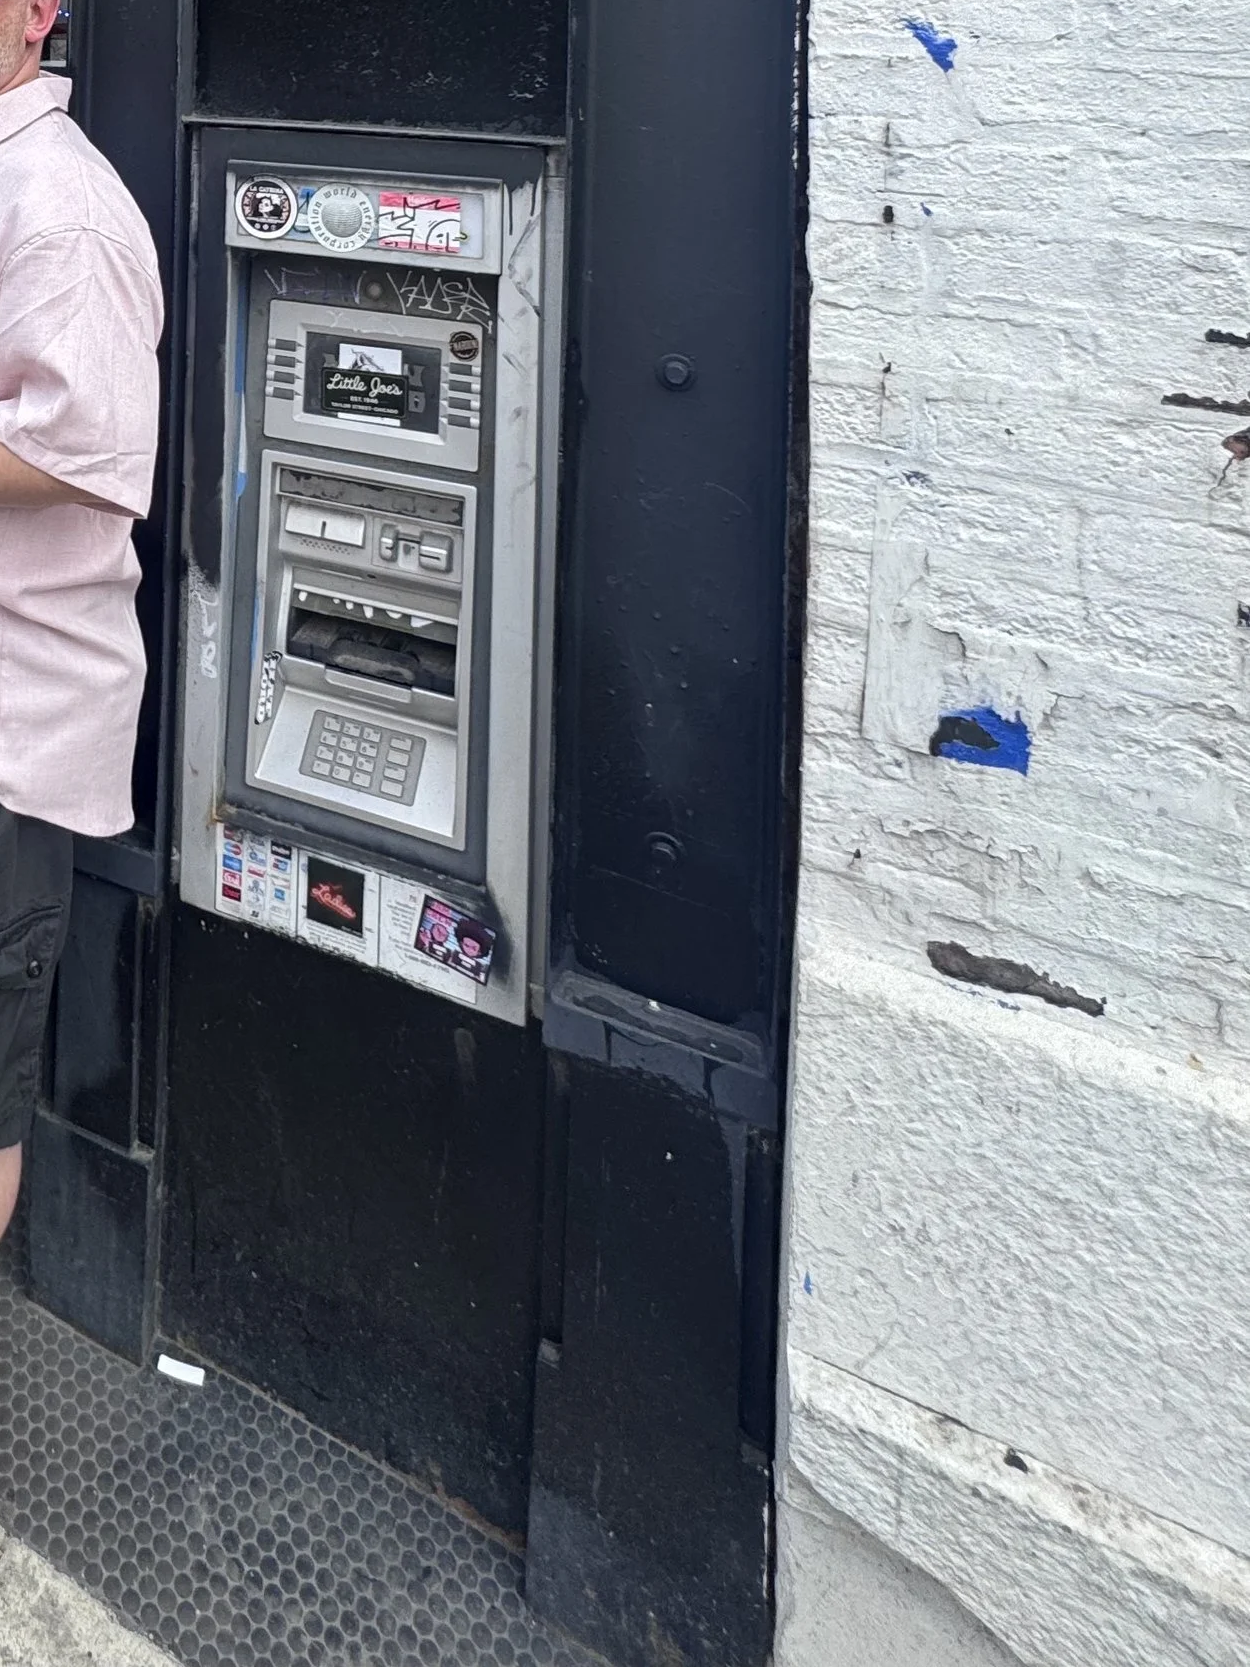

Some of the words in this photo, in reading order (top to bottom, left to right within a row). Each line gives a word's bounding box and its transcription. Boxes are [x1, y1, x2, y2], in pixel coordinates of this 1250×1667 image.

[323, 187, 357, 199] world
[326, 373, 367, 391] Little
[369, 377, 403, 398] Joe's
